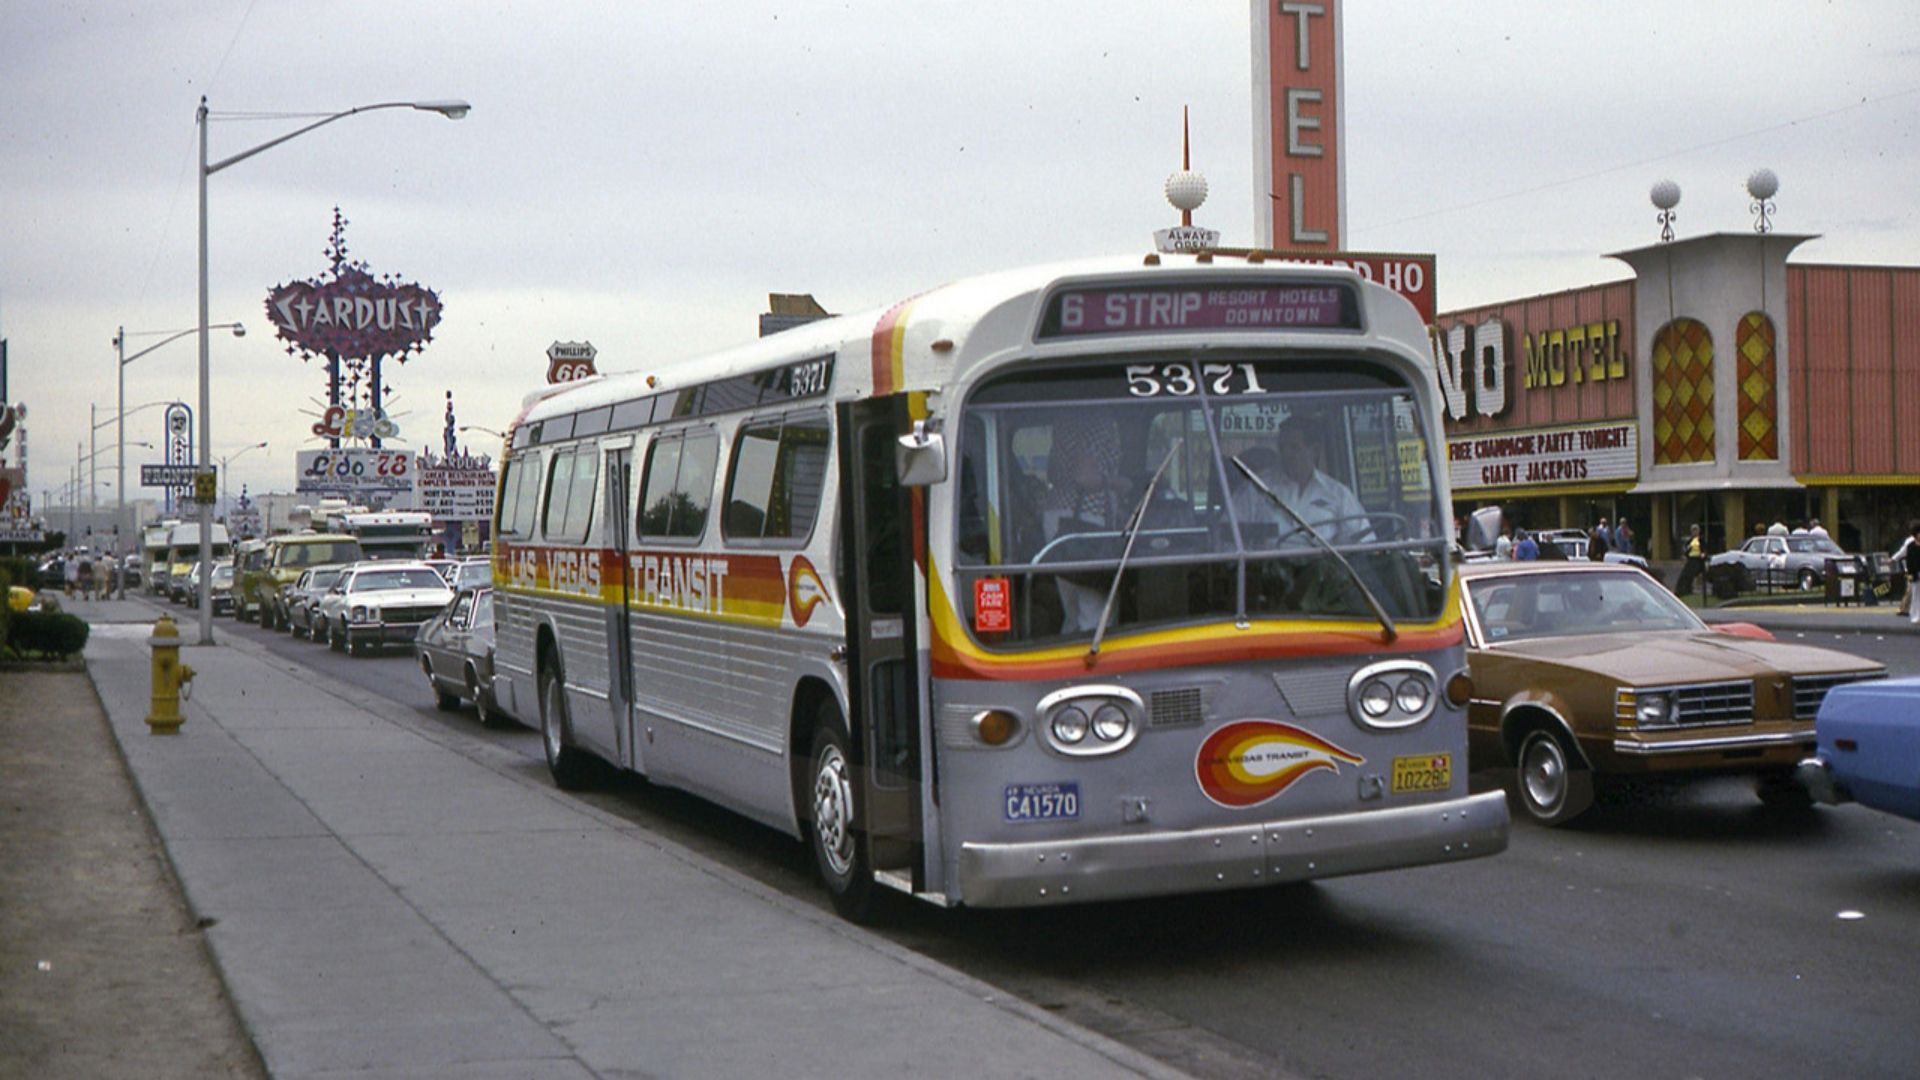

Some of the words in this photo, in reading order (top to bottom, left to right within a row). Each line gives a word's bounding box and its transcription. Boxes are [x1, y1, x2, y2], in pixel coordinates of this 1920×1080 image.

[1168, 230, 1213, 242] ALWAYS
[1384, 262, 1423, 293] HO
[274, 294, 435, 334] STARDUST
[1061, 293, 1084, 327] 6
[1105, 292, 1201, 326] STRIP
[1208, 290, 1267, 307] RESORT
[1279, 287, 1339, 305] HOTELS
[1225, 306, 1320, 324] DOWNTOWN
[554, 346, 591, 358] PHILLIPS
[1523, 320, 1627, 390] MOTEL
[556, 363, 588, 382] 66
[791, 361, 827, 398] 5371
[1126, 363, 1267, 397] 5371
[1450, 441, 1472, 461] FREE
[1474, 435, 1535, 460] CHAMPAGNE
[1538, 431, 1575, 455] PARTY
[1579, 427, 1629, 451] TONIGHT
[305, 454, 365, 478] Lido
[1482, 463, 1519, 485] GIANT
[1526, 458, 1588, 482] JACKPOTS
[418, 479, 447, 487] CMPLETE
[509, 549, 537, 590] LAS
[546, 550, 600, 594] VEGAS
[630, 558, 729, 616] TRANSIT
[1228, 755, 1263, 764] VEGAS
[1266, 750, 1310, 761] TRANSIT
[1008, 793, 1077, 819] C41570
